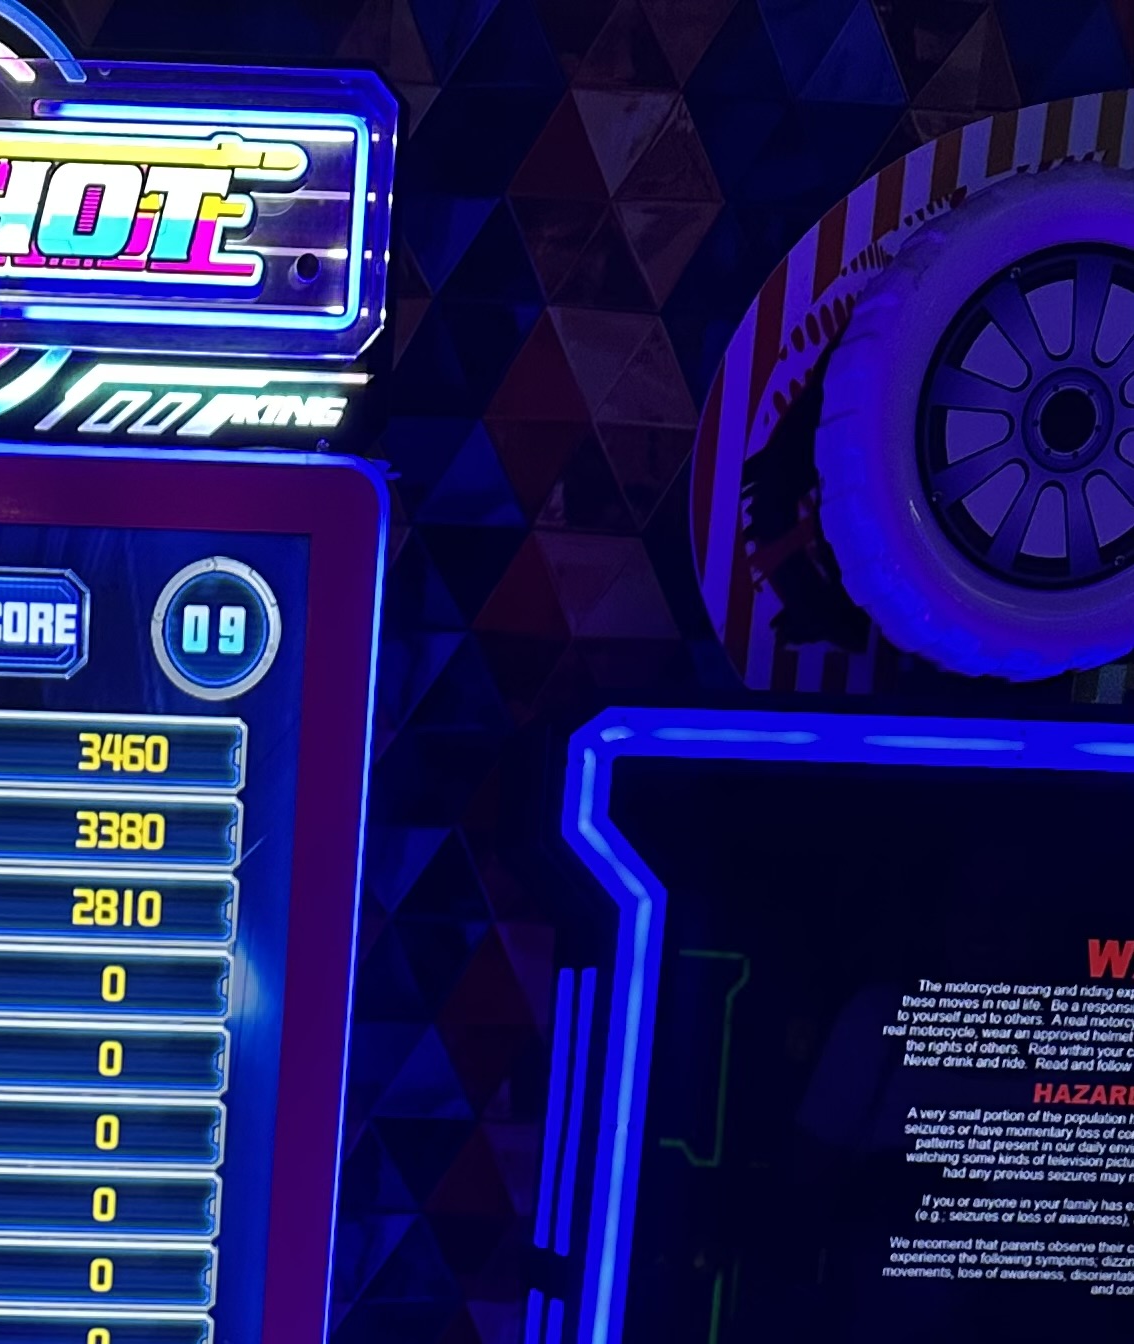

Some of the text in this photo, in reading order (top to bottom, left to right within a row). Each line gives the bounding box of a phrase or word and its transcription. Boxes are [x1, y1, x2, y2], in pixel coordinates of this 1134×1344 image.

[230, 395, 347, 427] KING
[182, 604, 247, 654] 09
[80, 733, 169, 773] 3460
[77, 811, 165, 850] 3380
[72, 888, 162, 927] 2810
[101, 965, 126, 1002] 0
[919, 980, 1113, 1000] The motorcycle racing and riding
[98, 1040, 123, 1077] 0
[904, 1054, 1132, 1072] Never drink and ride. Read and follow
[1033, 1083, 1134, 1106] HAZAR
[907, 1107, 1126, 1125] A very small portion the population
[95, 1114, 119, 1150] 0
[905, 1123, 1115, 1140] seizures have momentary loss of
[906, 1152, 1103, 1167] watching some kinds television
[916, 1138, 1106, 1154] patterns that present daily
[943, 1166, 1096, 1182] had any previous seizures
[92, 1187, 116, 1222] 0
[933, 1198, 1122, 1212] you anyone your family has
[890, 1236, 1125, 1253] We recomend that parents observe their
[89, 1258, 113, 1292] 0
